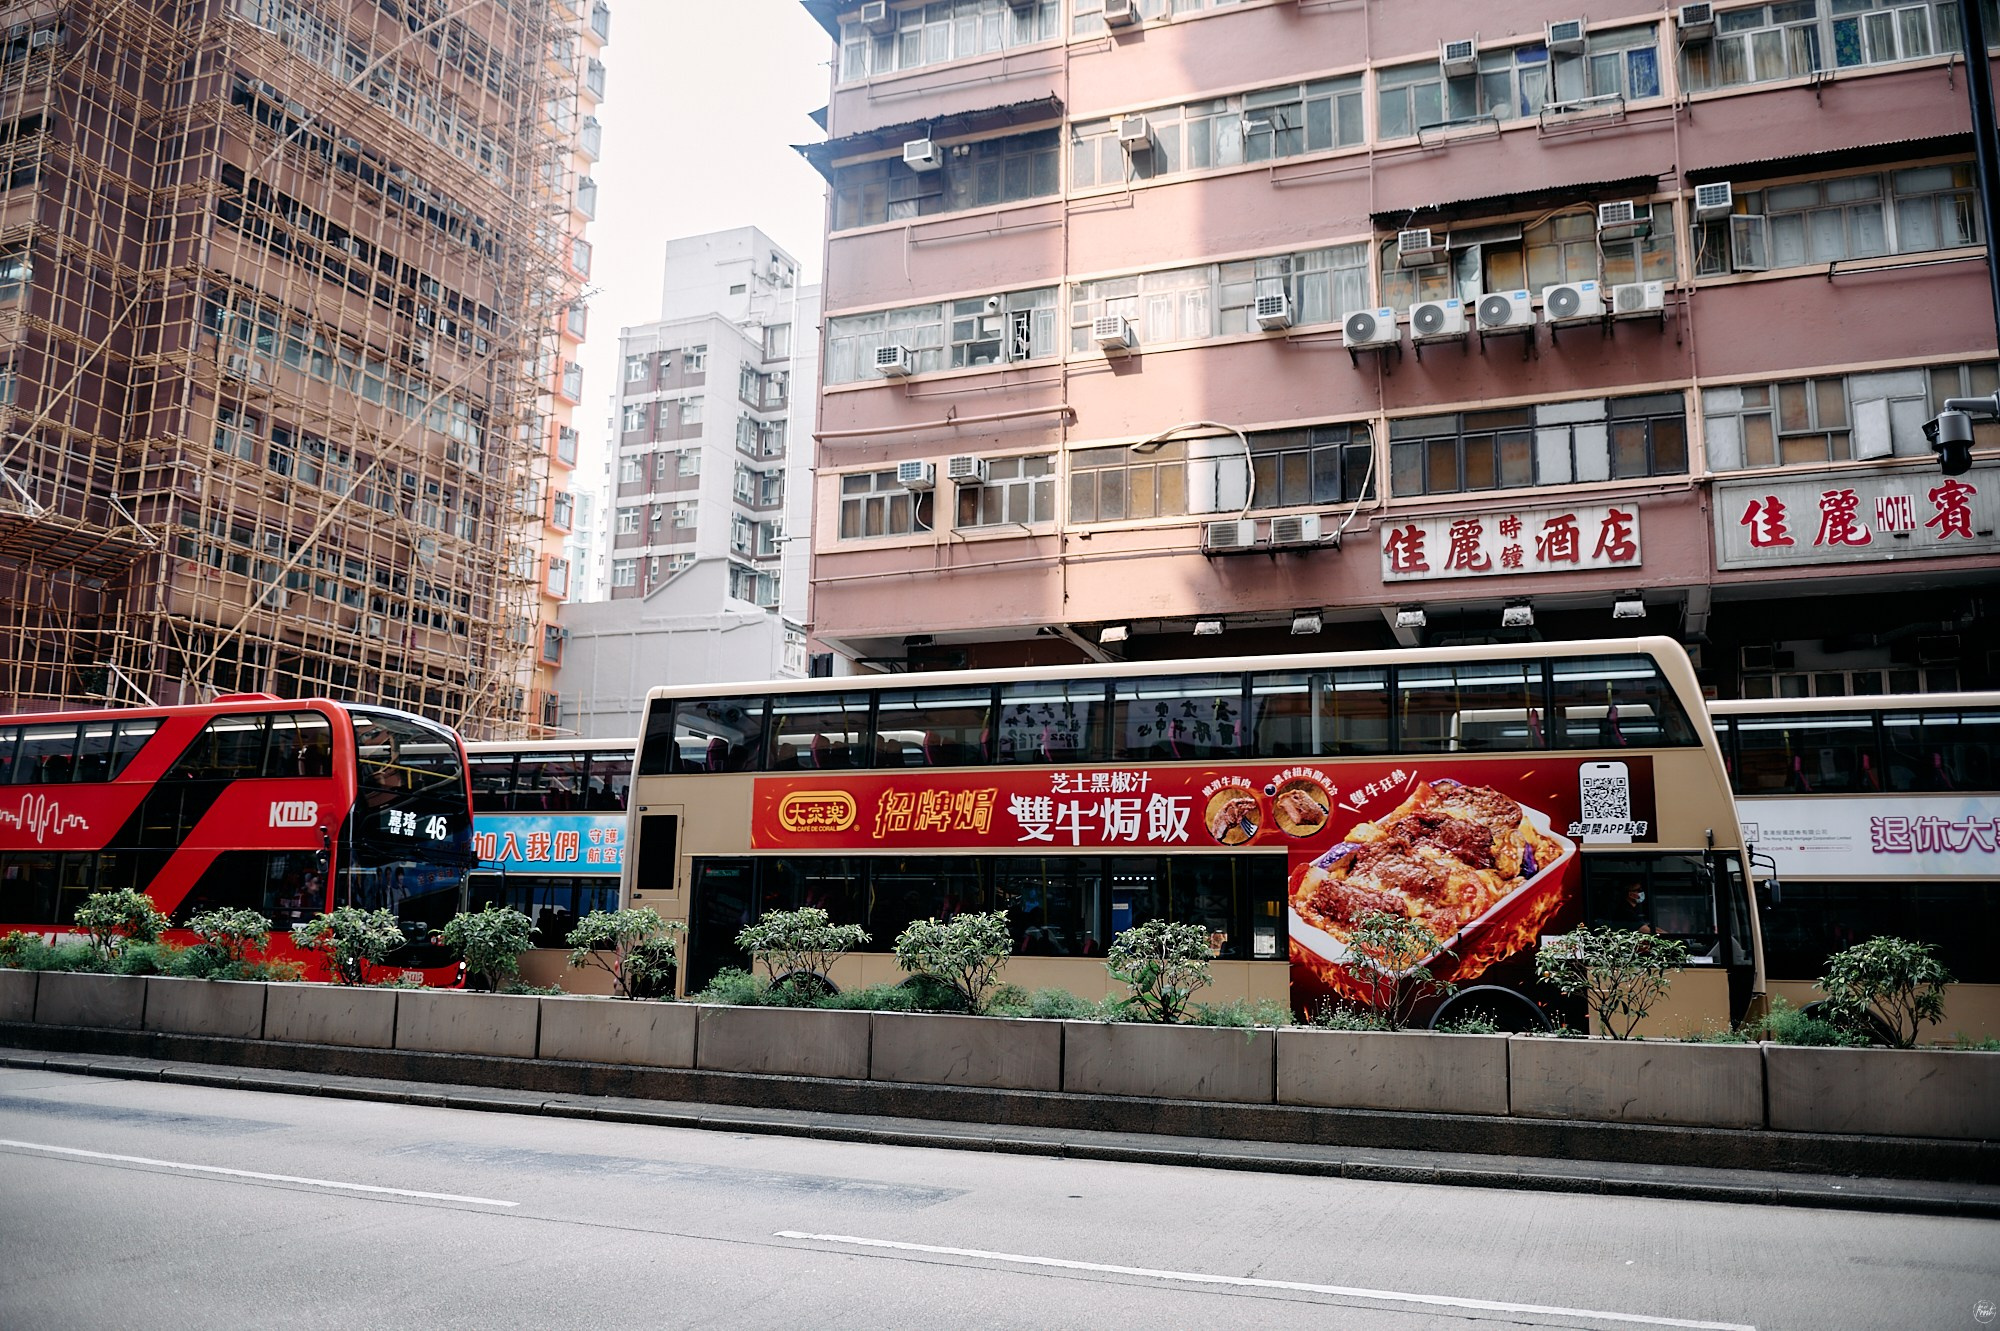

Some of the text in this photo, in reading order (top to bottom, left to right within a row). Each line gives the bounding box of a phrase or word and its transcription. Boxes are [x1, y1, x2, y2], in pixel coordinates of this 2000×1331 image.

[1741, 479, 1977, 548] 佳麗 HOTEL 賓
[1050, 771, 1152, 794] 芝士黑椒汁
[1349, 769, 1407, 809] 雙牛狂熱
[269, 801, 318, 827] KMB
[425, 816, 447, 840] 46
[873, 788, 998, 838] 招牌焗
[1007, 793, 1193, 846] 雙牛焗飯
[474, 832, 579, 862] 加入我們
[590, 829, 617, 843] 守護
[1870, 815, 2000, 853] 退休大
